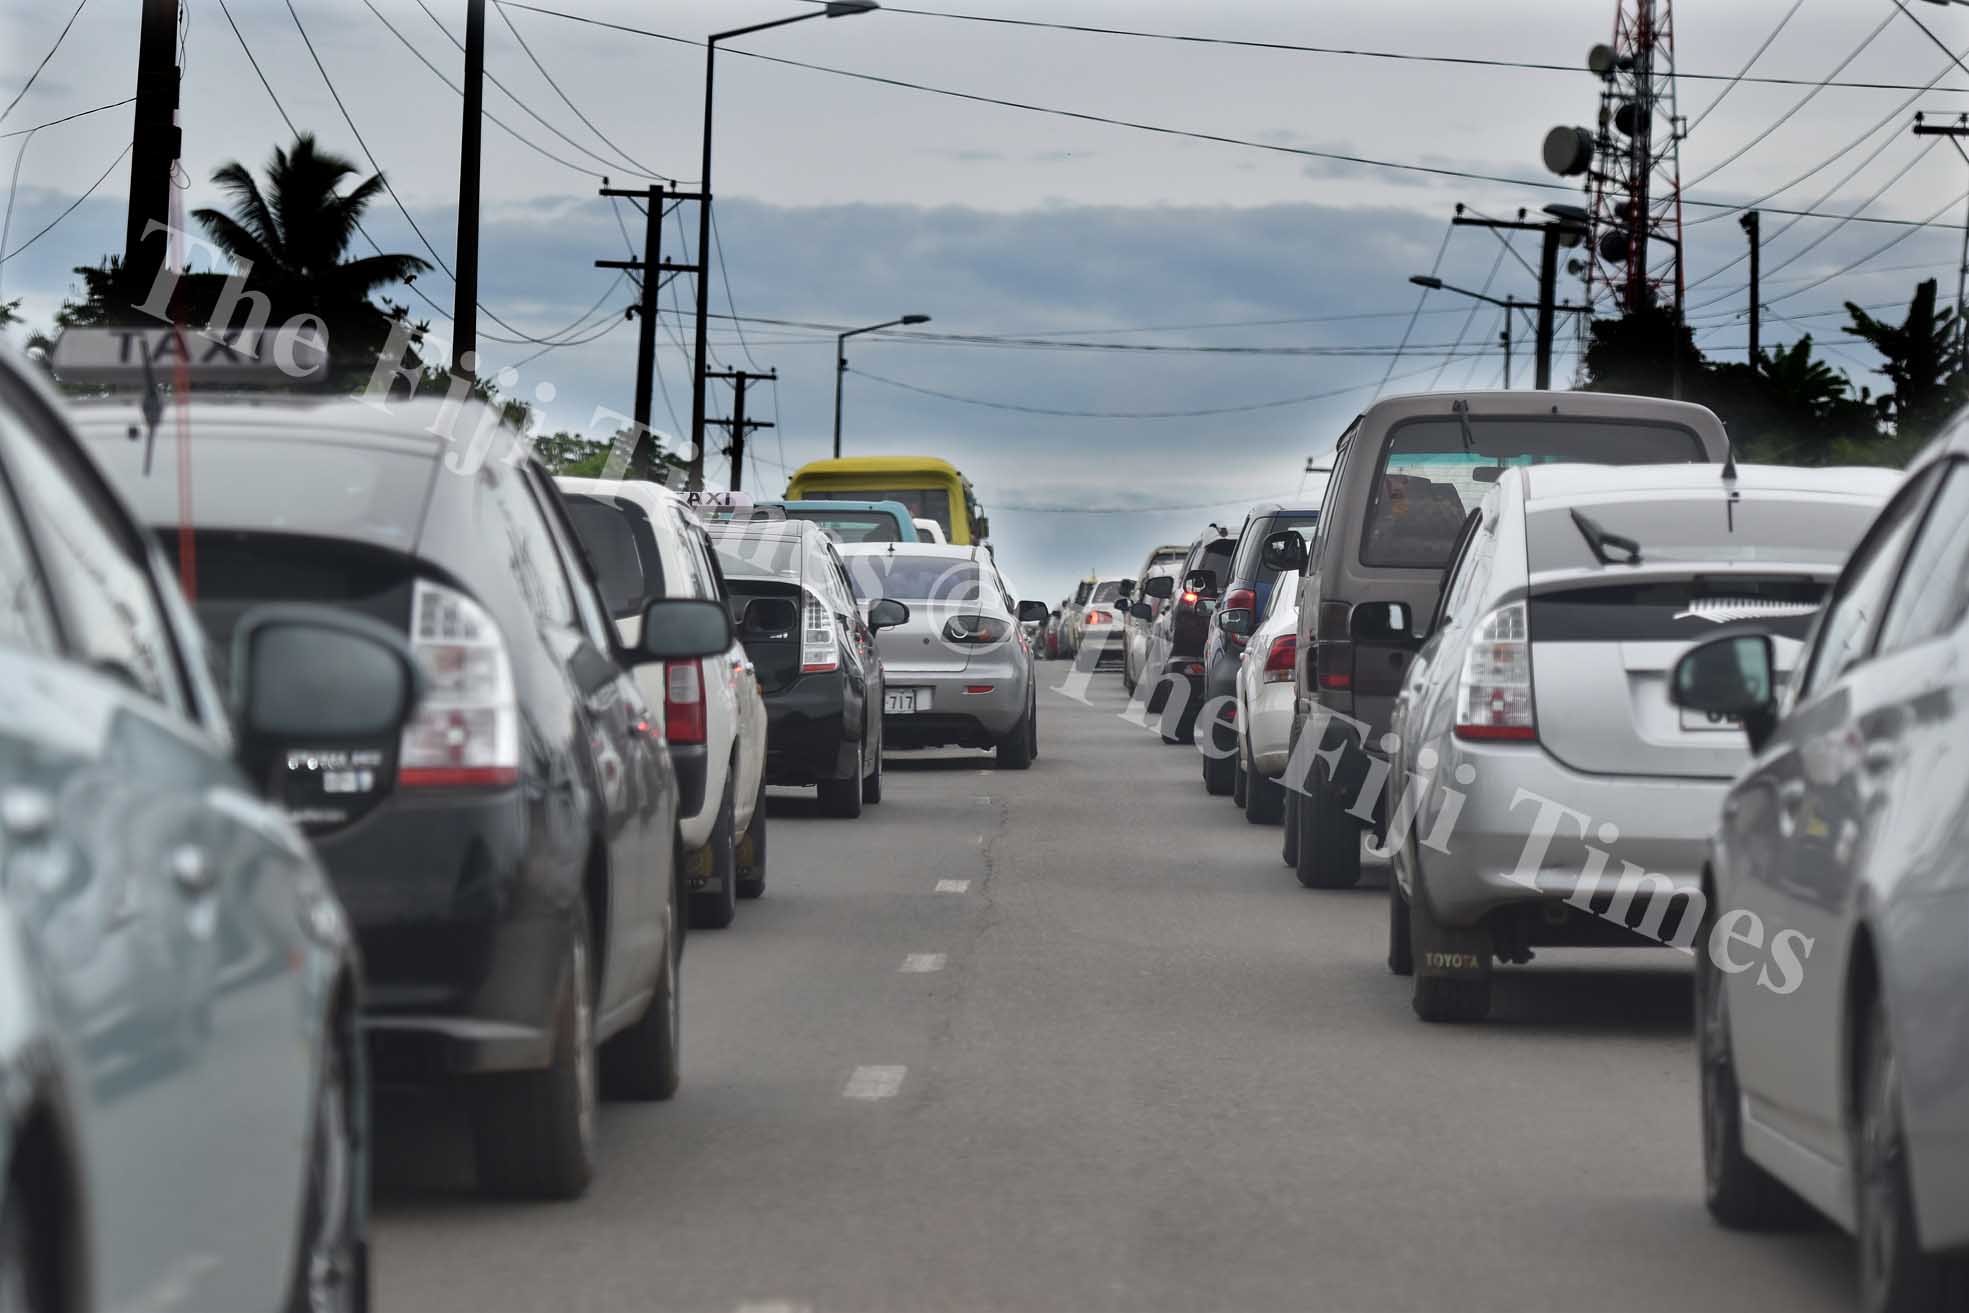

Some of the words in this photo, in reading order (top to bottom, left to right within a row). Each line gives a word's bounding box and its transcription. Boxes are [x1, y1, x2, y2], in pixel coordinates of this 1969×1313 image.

[109, 331, 263, 363] TAXI
[677, 492, 731, 506] AXI
[1425, 952, 1479, 968] TOYOTA
